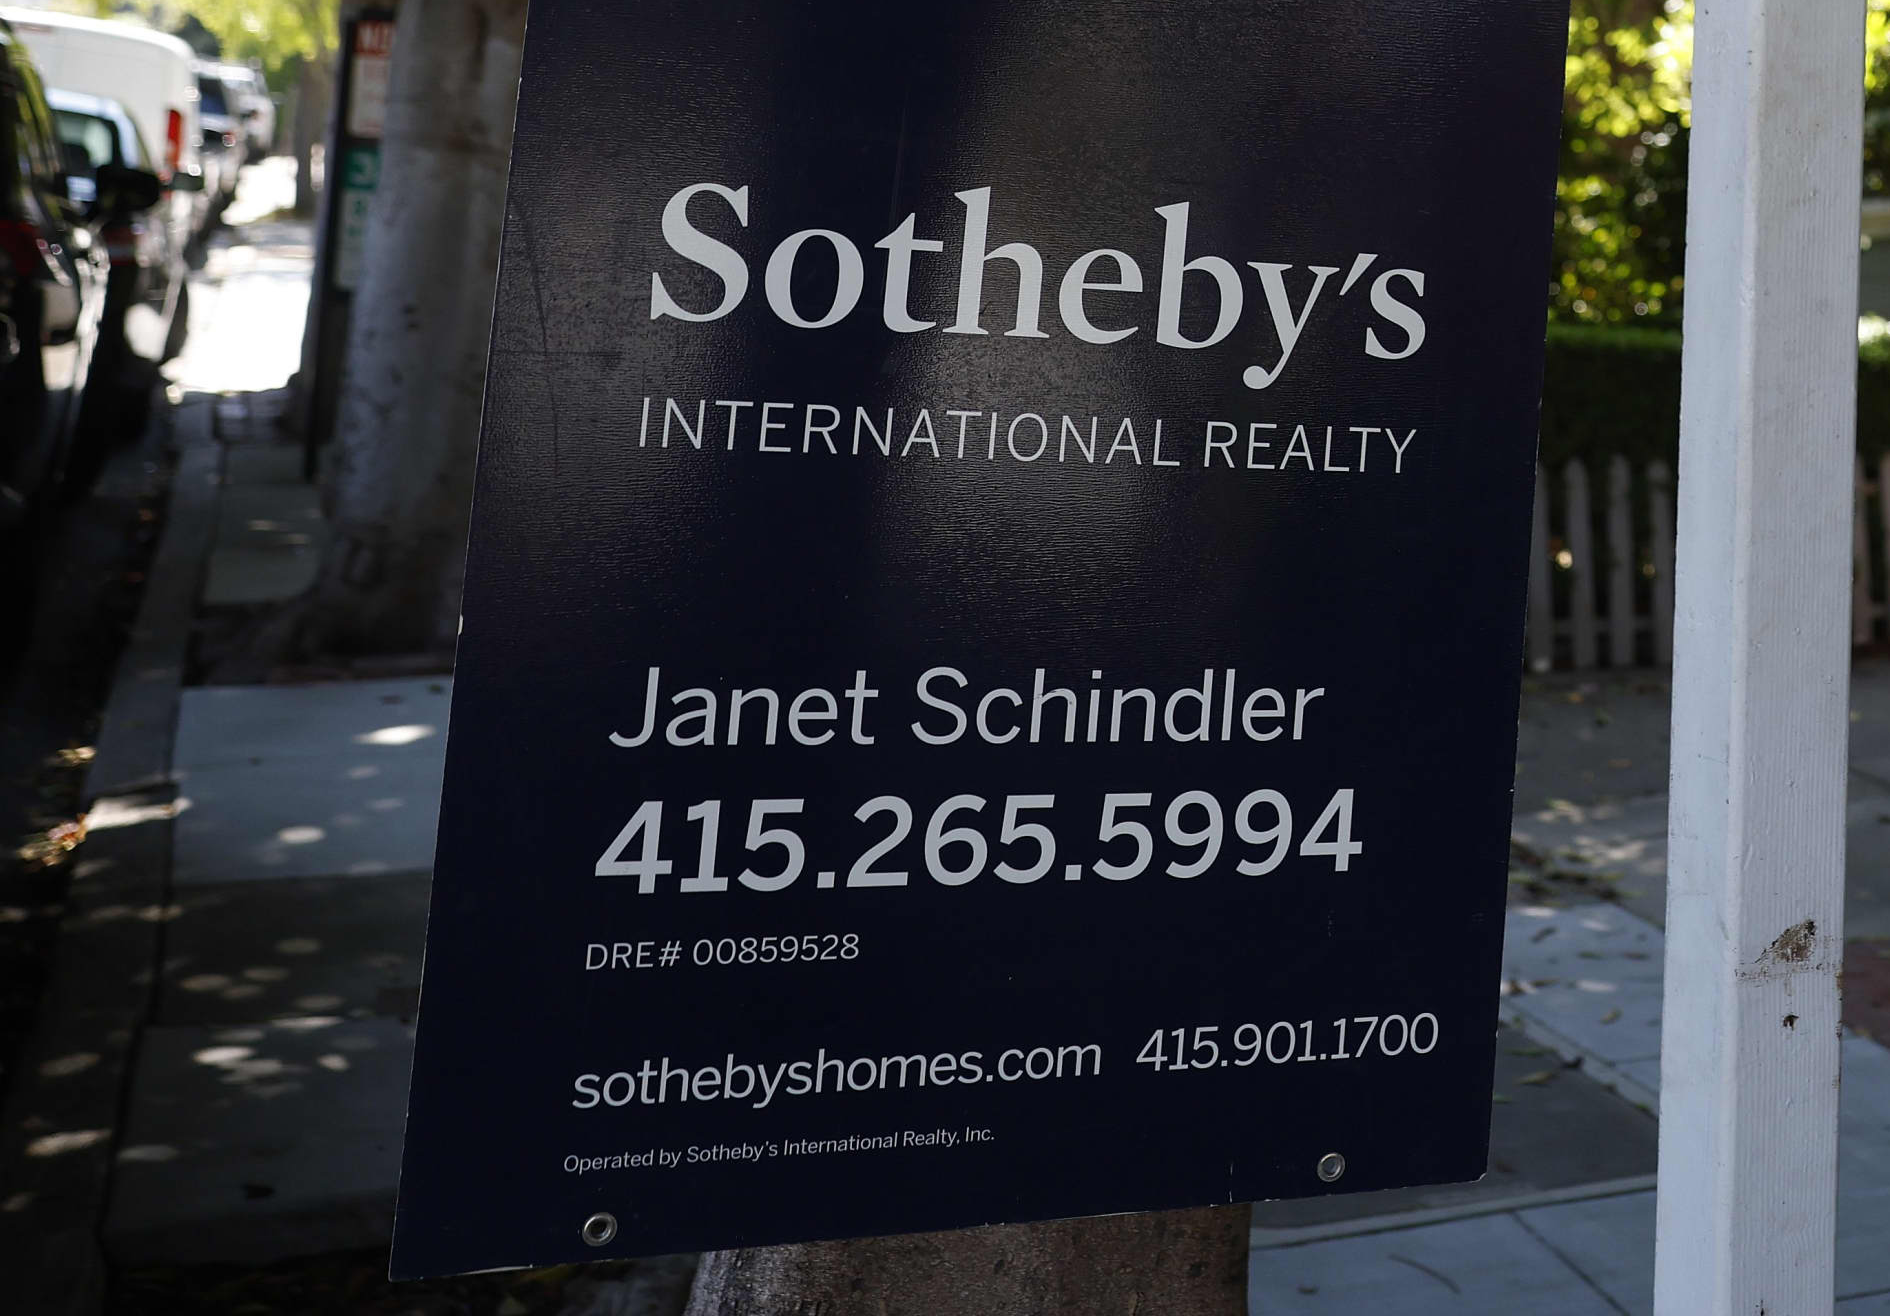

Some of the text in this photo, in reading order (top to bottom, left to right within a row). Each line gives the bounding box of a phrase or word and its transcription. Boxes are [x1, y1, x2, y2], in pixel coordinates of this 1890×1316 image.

[649, 182, 1426, 390] Sotheby's
[639, 396, 1417, 474] INTERNATIONAL REALTY
[608, 666, 1325, 748] Janet Schindler
[594, 788, 1363, 894] 415.265.5994
[585, 933, 859, 971] DRE# 00859528
[572, 1012, 1439, 1109] sothebyshomes.com 415.901.1700
[563, 1126, 996, 1176] Operated by Sotheby's International Realty, Inc.
